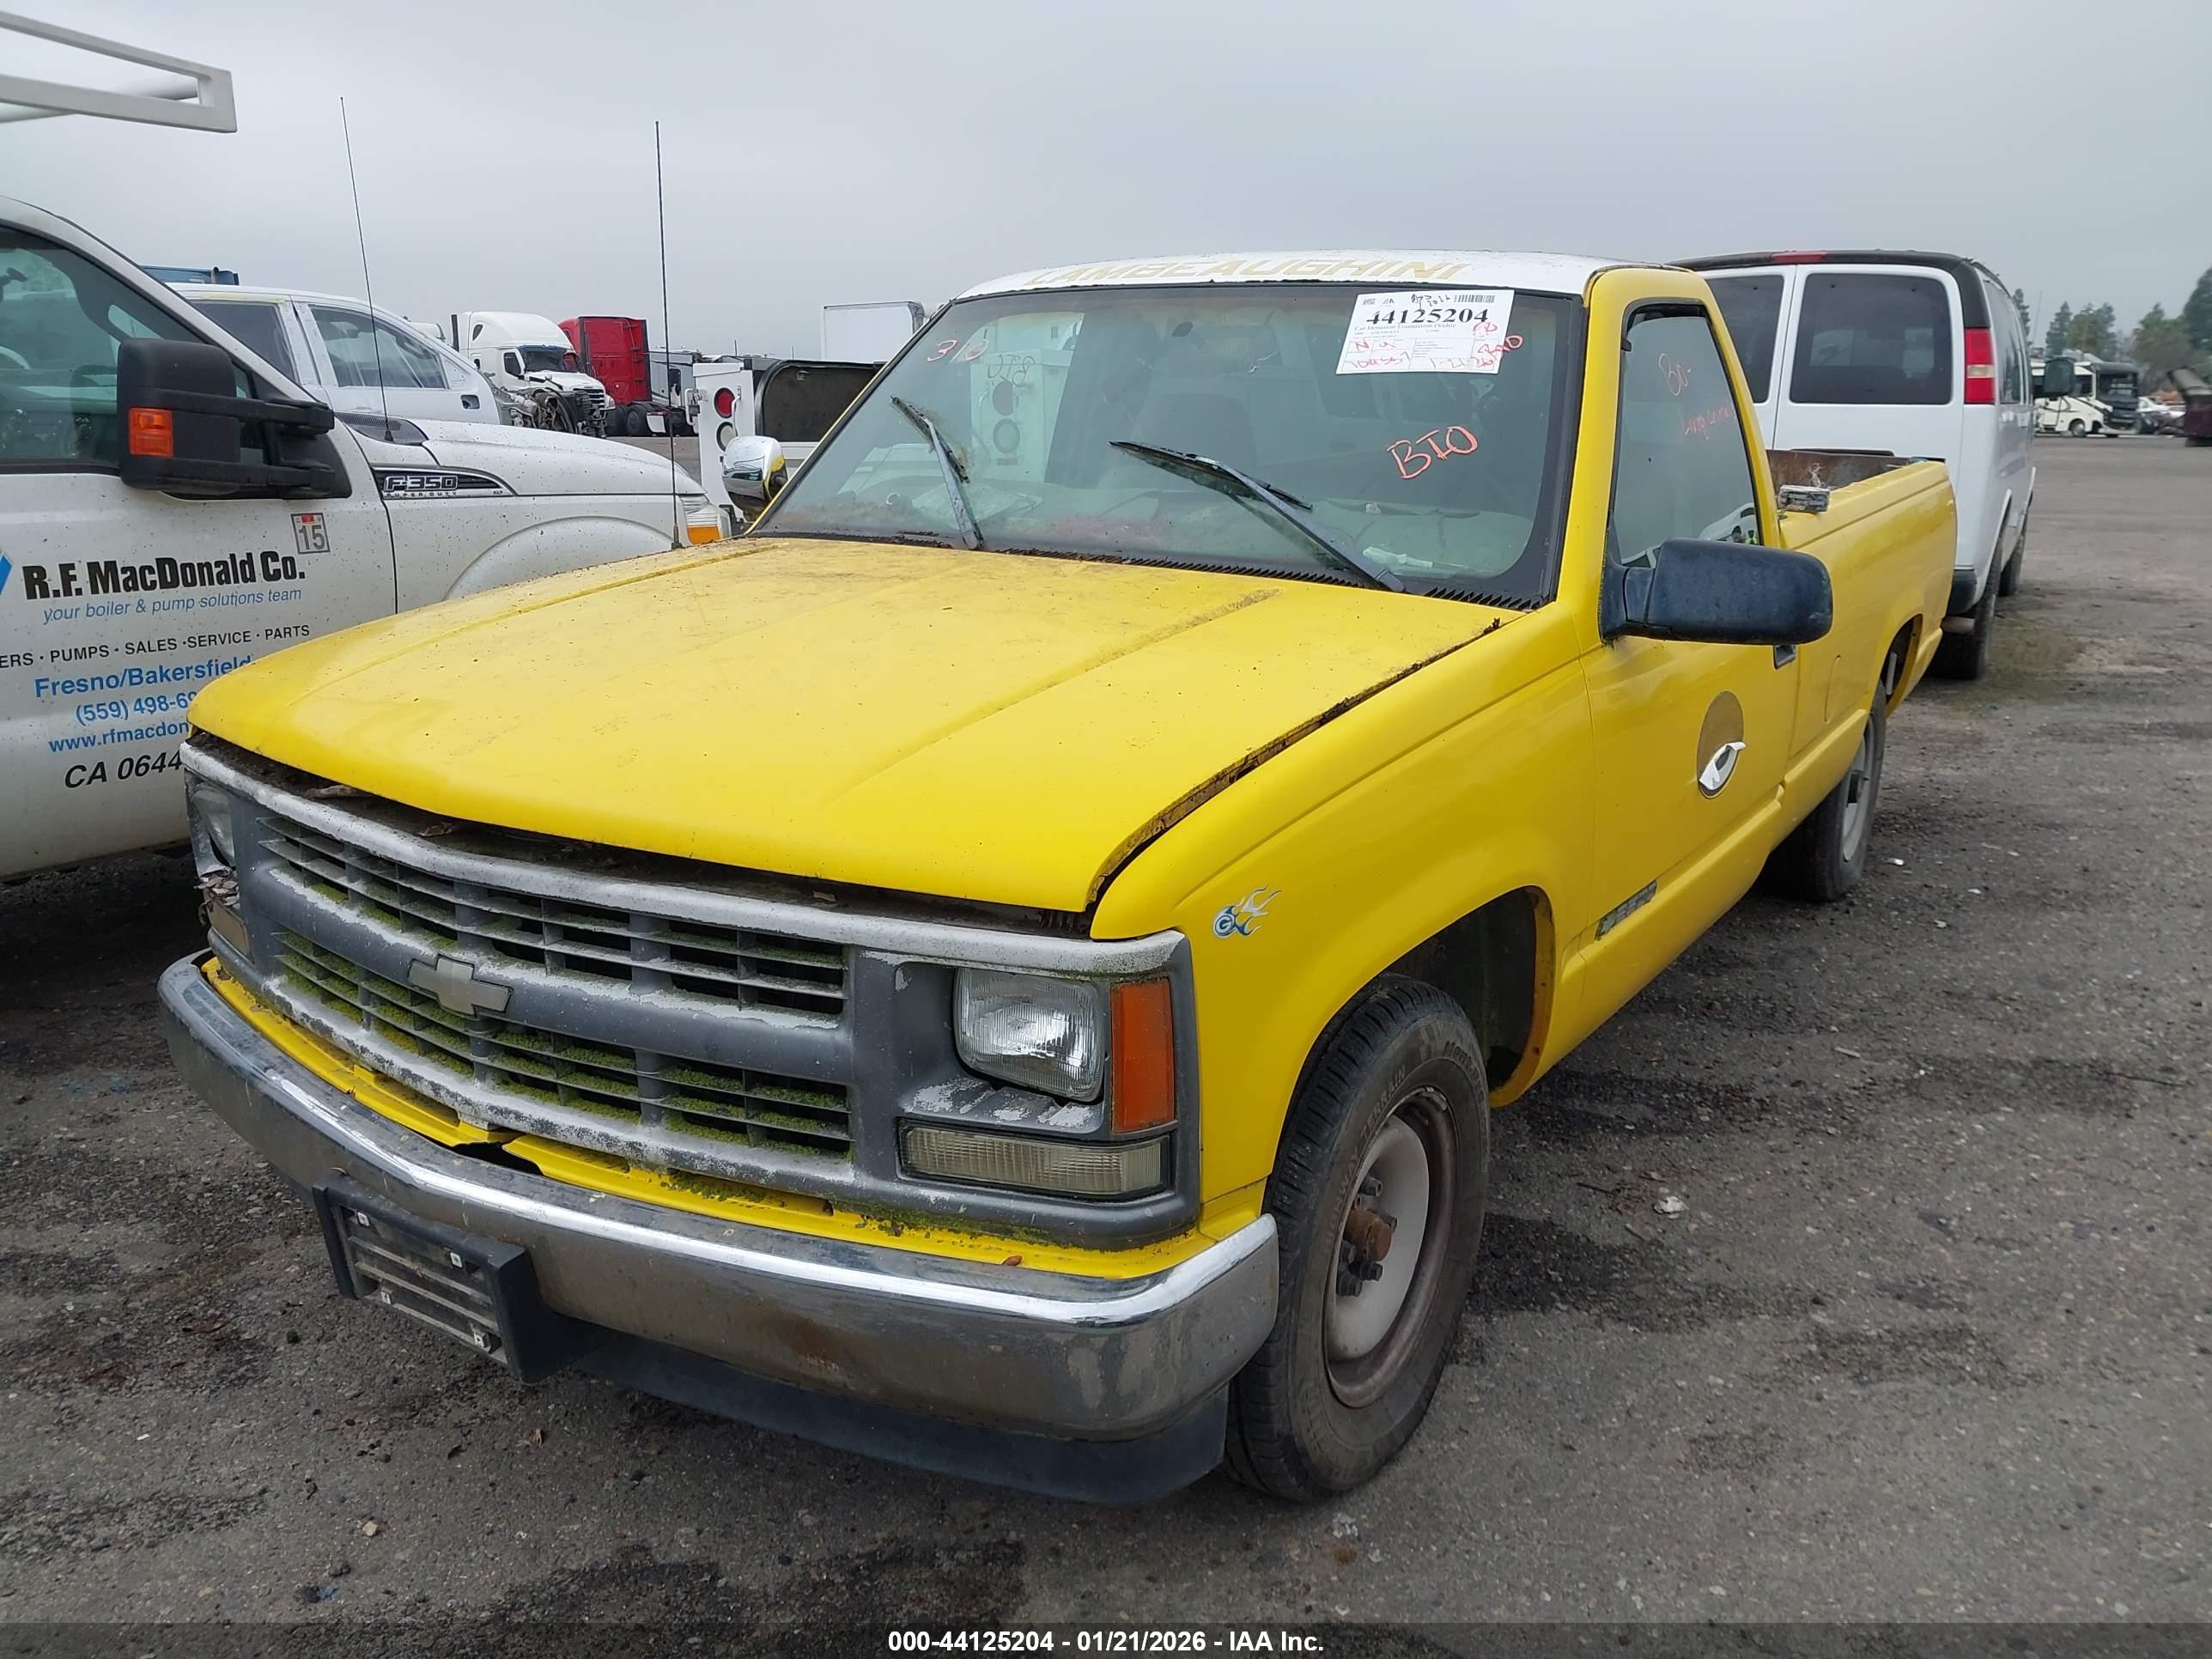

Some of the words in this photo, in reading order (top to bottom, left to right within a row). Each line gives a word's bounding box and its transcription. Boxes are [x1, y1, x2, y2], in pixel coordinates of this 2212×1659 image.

[1366, 307, 1489, 325] 44125204
[1387, 426, 1478, 478] BIO
[384, 475, 459, 492] F-350
[298, 525, 325, 550] 15
[22, 563, 83, 600] R.F.
[87, 552, 257, 595] MacDonald
[260, 550, 306, 582] Co.
[43, 606, 81, 626] your
[86, 601, 131, 618] boiler
[136, 599, 146, 613] &
[152, 596, 195, 616] pump
[199, 592, 264, 608] solutions
[268, 589, 301, 602] team
[50, 645, 110, 663] PUMPS
[125, 638, 178, 655] SALES
[187, 630, 252, 649] SERVICE
[264, 625, 310, 641] PARTS
[76, 700, 129, 726] (559)
[64, 761, 108, 789] CA
